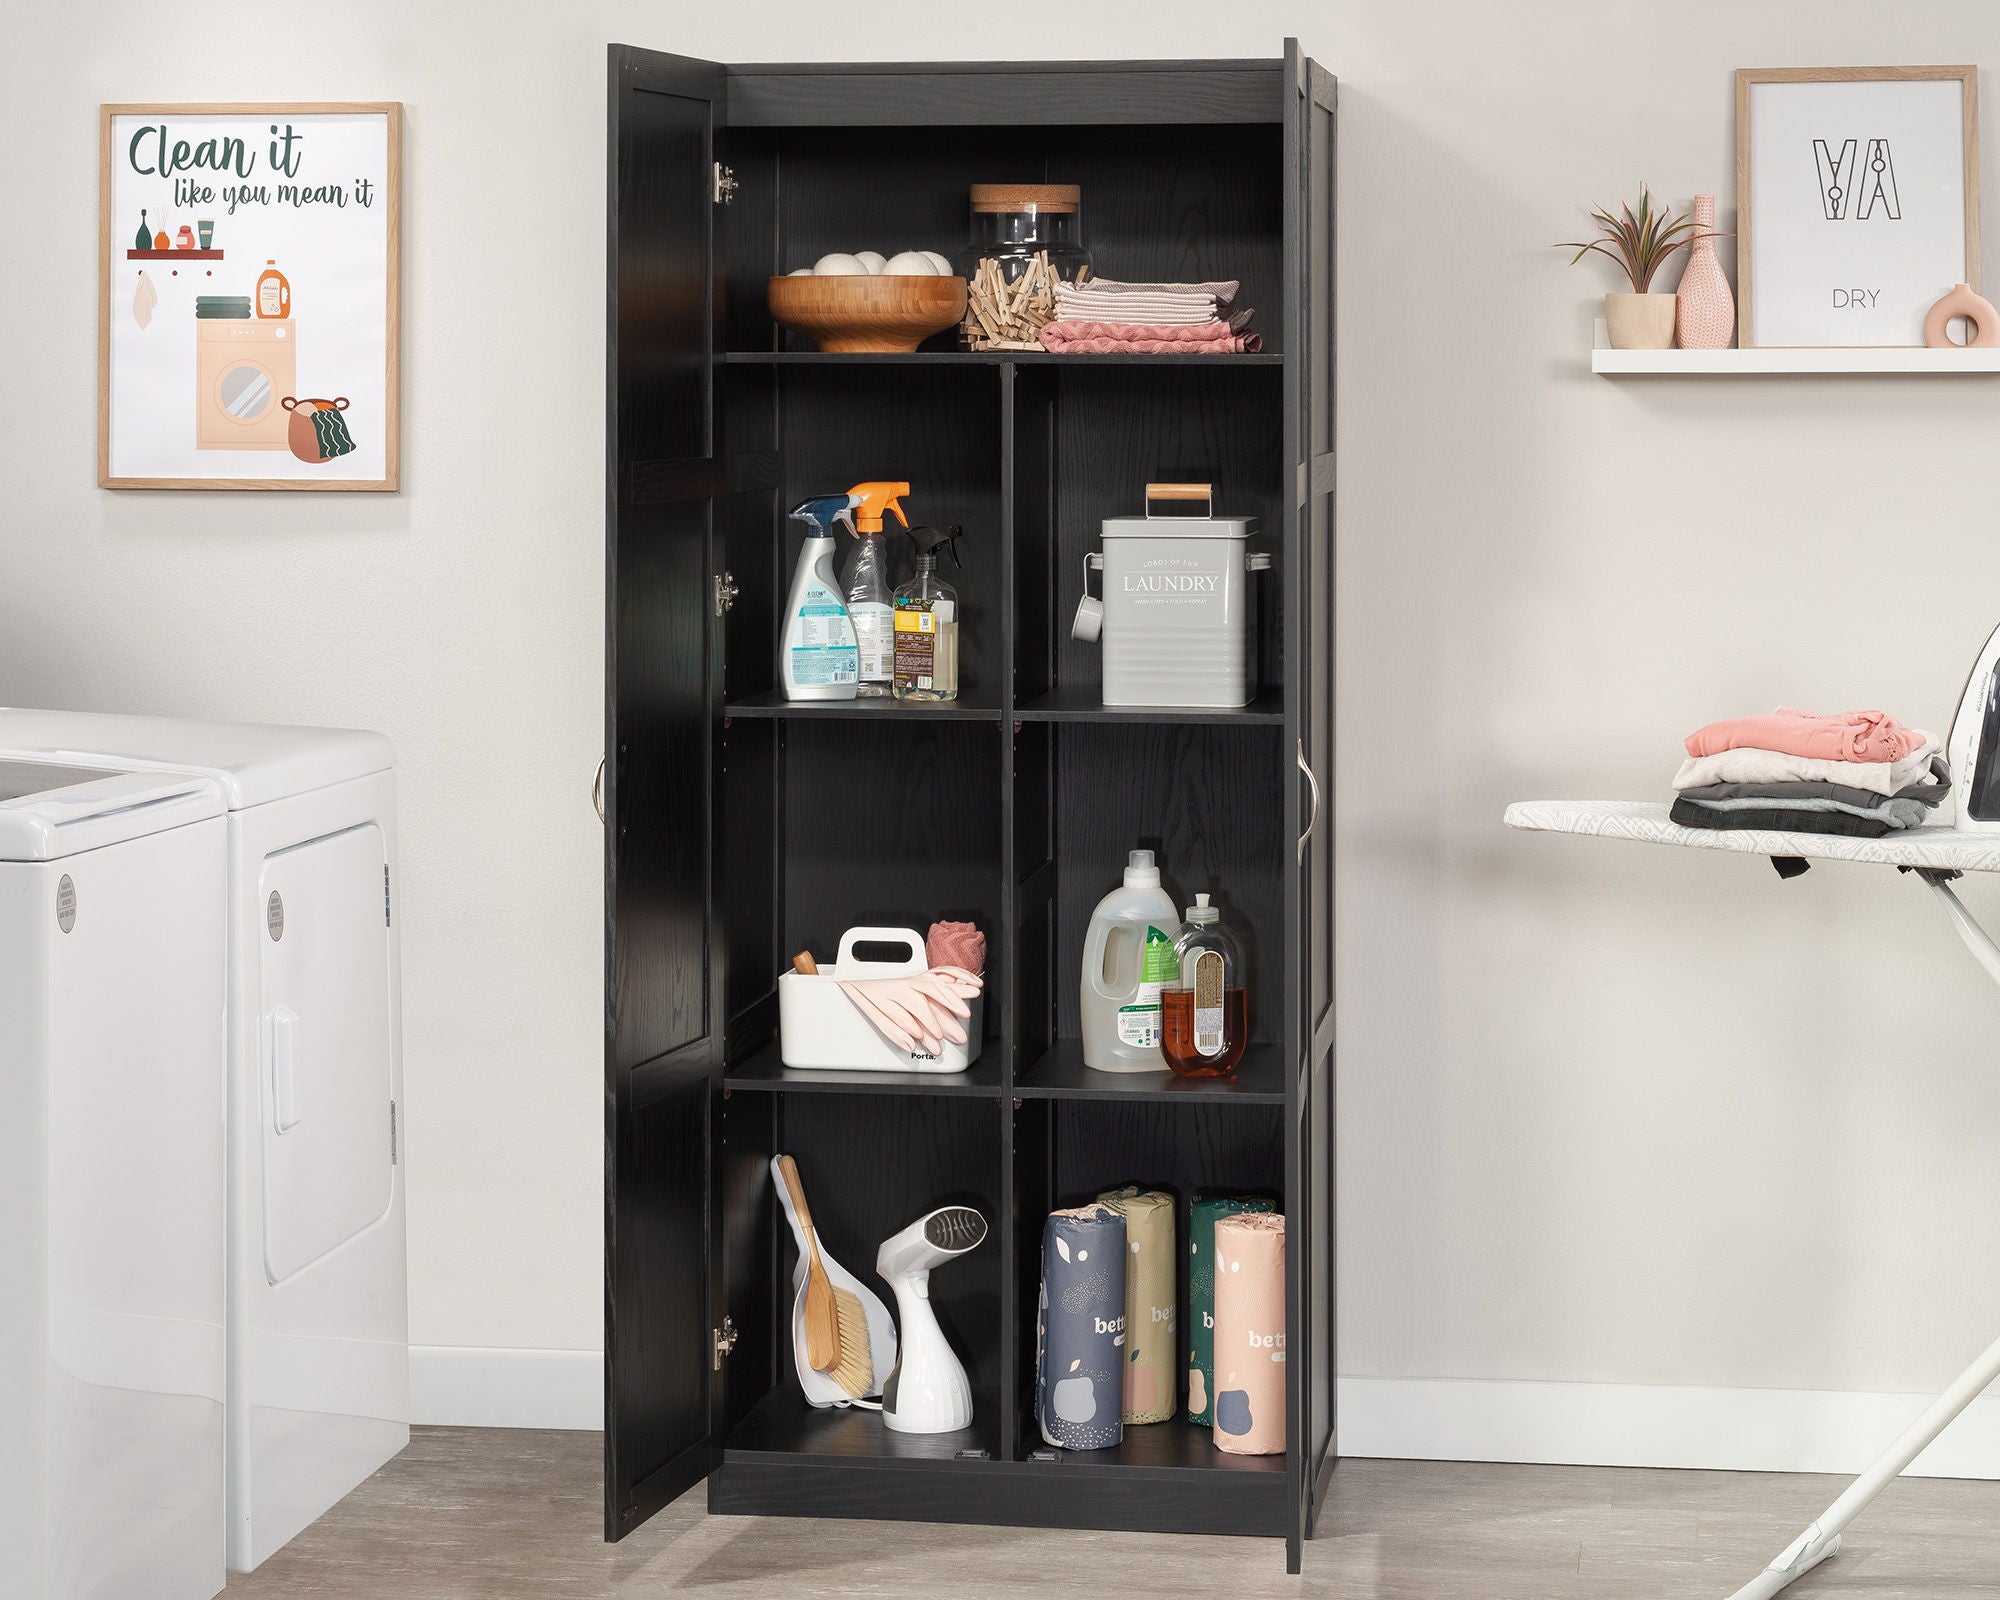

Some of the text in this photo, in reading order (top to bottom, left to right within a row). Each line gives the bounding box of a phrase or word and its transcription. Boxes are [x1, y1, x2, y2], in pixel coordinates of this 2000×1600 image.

[129, 124, 303, 179] Clean it
[174, 178, 374, 216] like you mean it
[1832, 288, 1881, 309] DRY
[1124, 576, 1219, 592] LAUNDRY
[911, 1052, 936, 1060] Porta.
